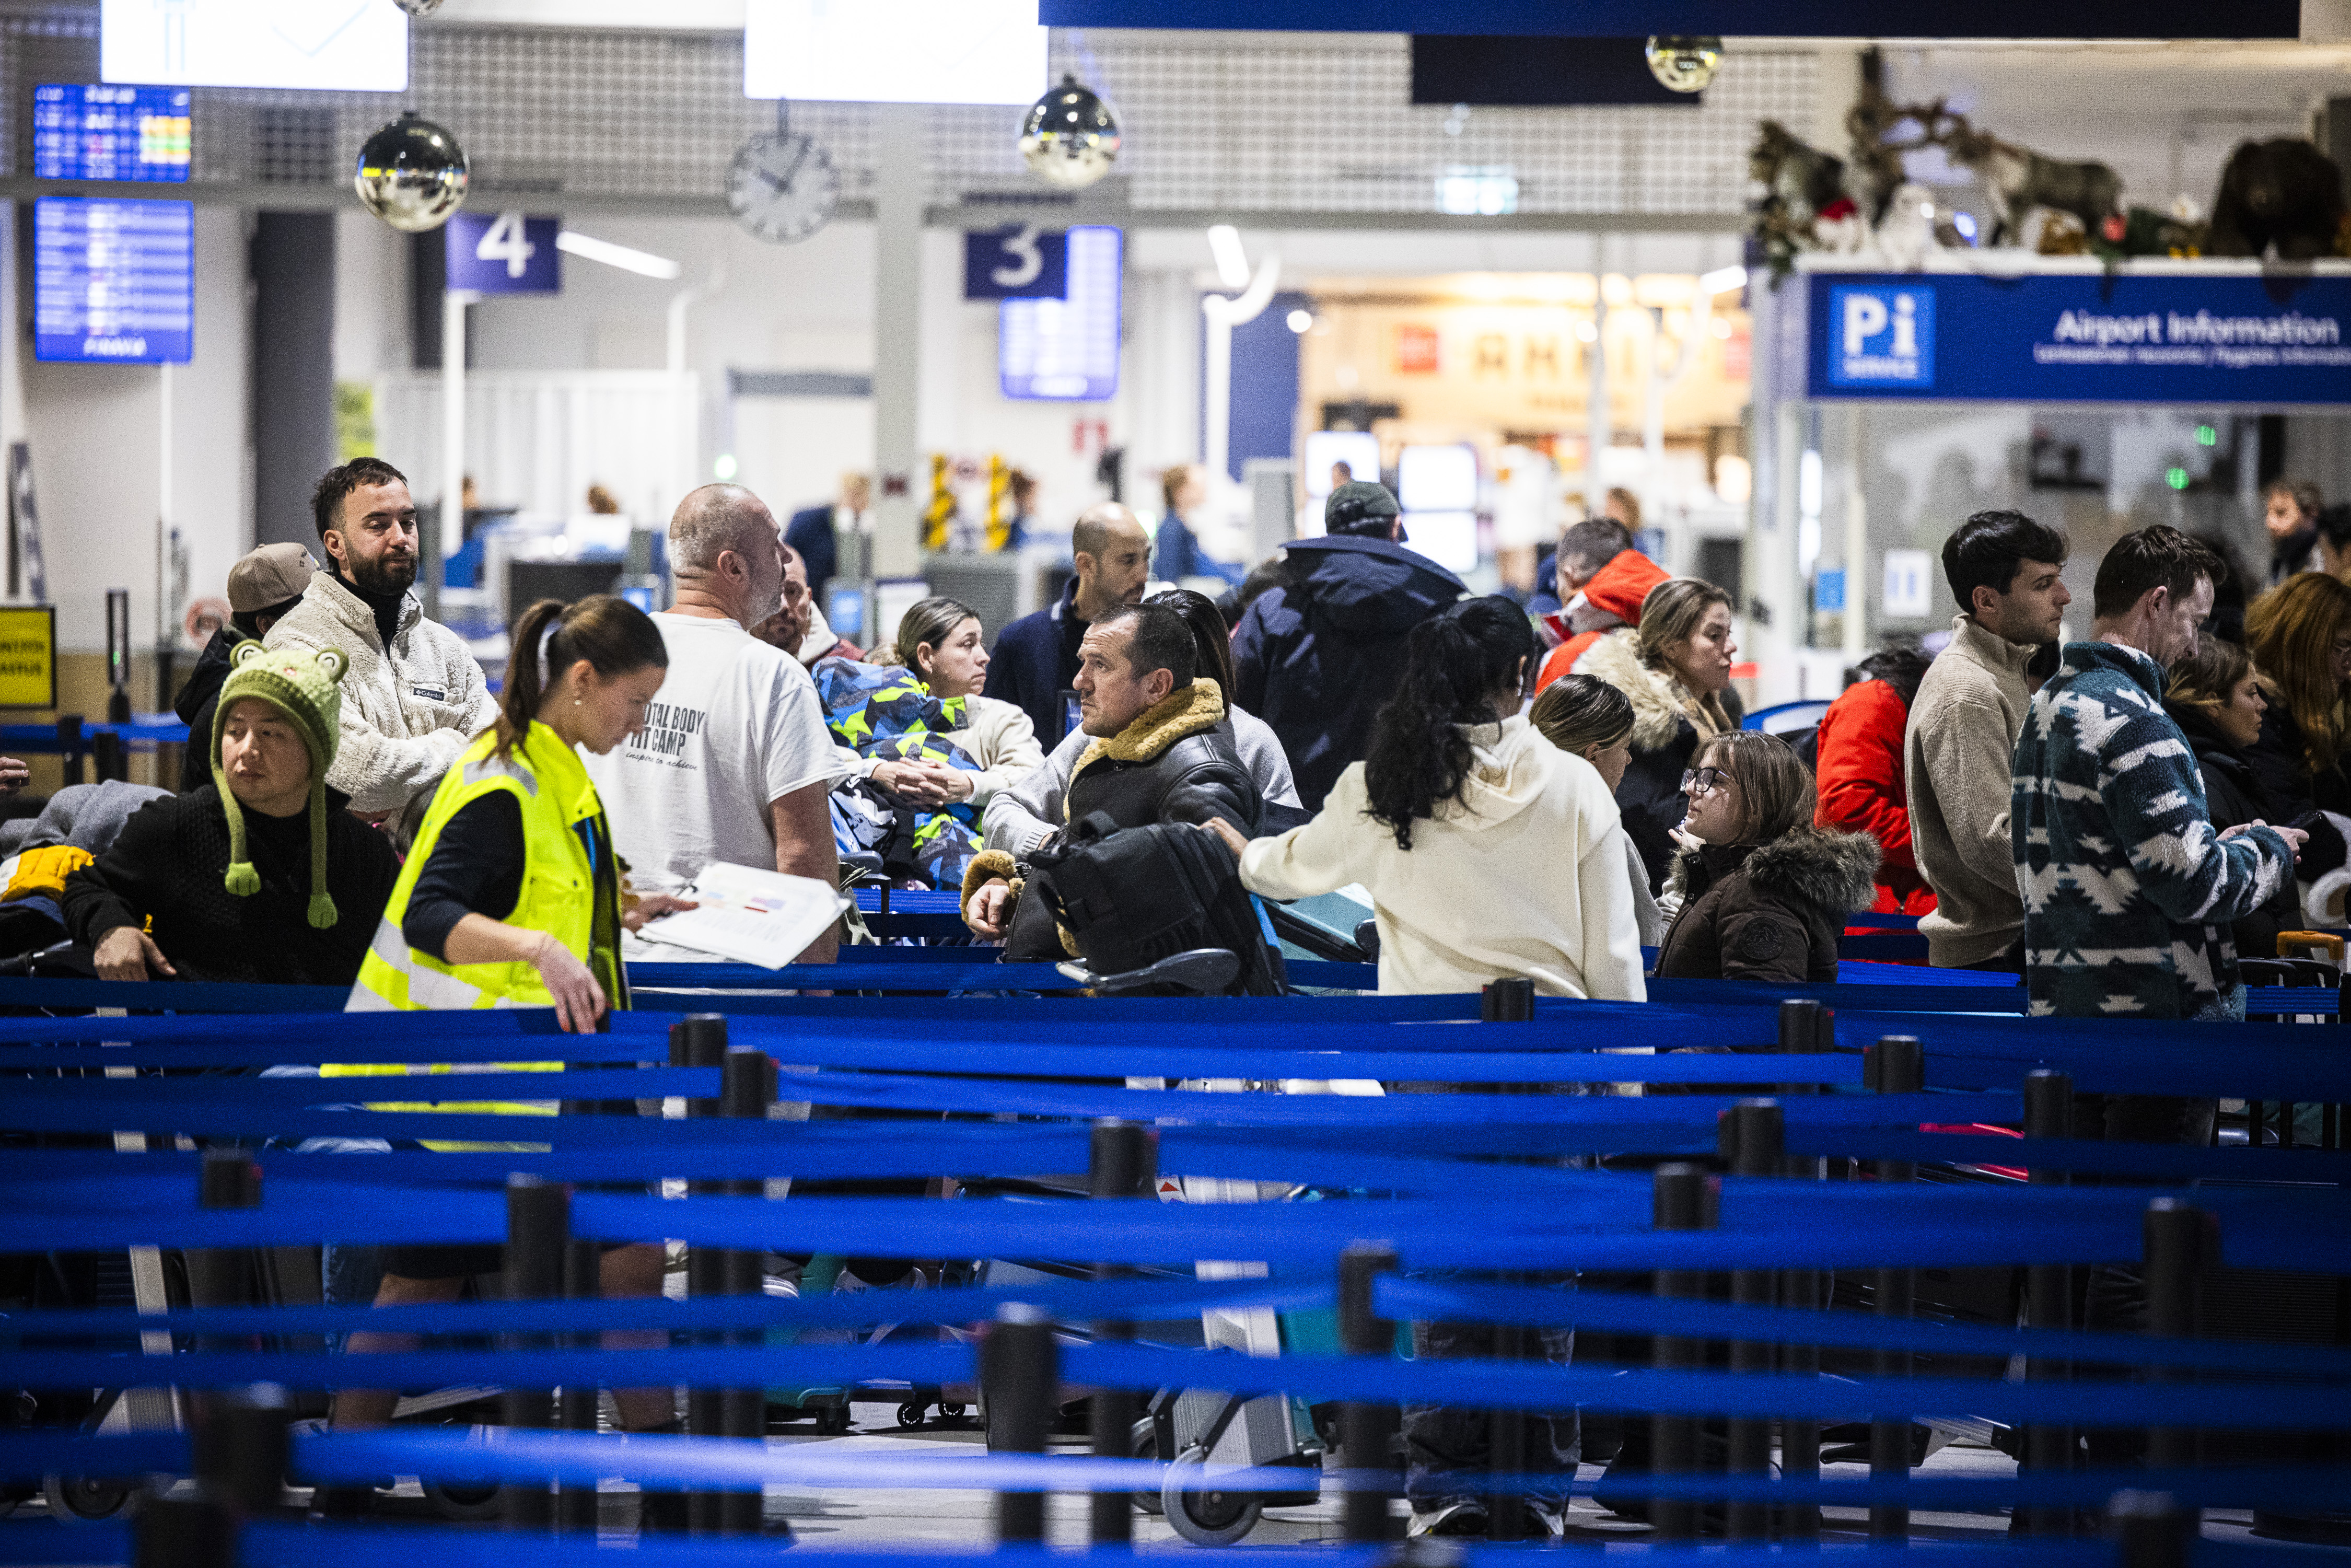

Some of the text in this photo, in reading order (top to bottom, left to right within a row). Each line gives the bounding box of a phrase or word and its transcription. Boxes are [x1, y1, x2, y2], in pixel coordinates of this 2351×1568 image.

[476, 211, 535, 278] 4
[991, 215, 1044, 287] 3
[1844, 294, 1917, 354] Pi
[2053, 309, 2340, 347] Airport Information
[421, 691, 442, 699] Columbia
[643, 703, 705, 735] OTAL BODY
[652, 728, 686, 756] CAMP
[666, 760, 698, 771] achieve
